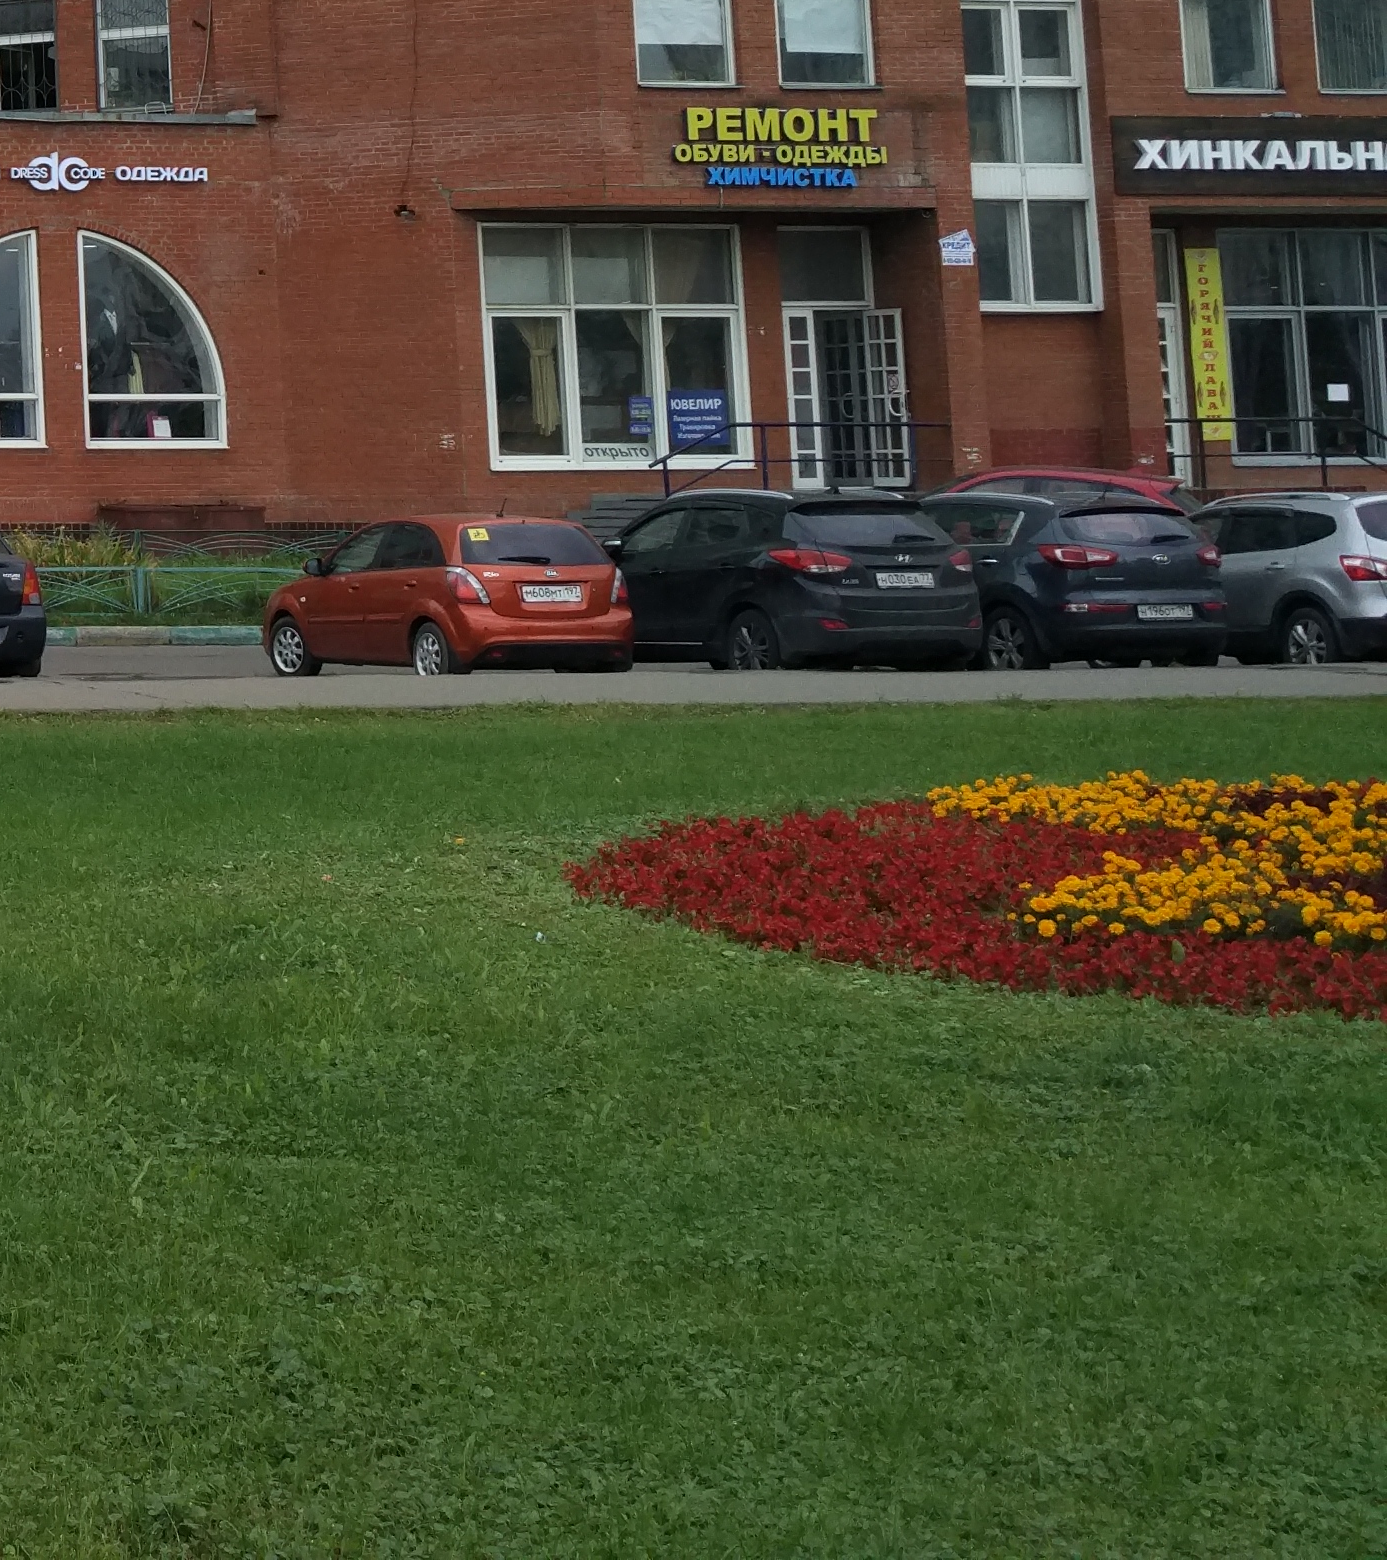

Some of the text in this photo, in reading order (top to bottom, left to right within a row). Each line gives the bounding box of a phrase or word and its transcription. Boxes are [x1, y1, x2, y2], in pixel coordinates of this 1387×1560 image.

[686, 107, 878, 142] РЕМОНТ
[674, 144, 755, 162] ОБУВИ
[776, 145, 888, 167] ОДЕЖДЫ
[1132, 139, 1387, 171] ХИНКАЛЬН
[11, 168, 106, 180] DRESS CODE
[115, 167, 208, 182] ОДЕЖДА
[707, 166, 858, 187] ХИМЧИСТКА
[1197, 264, 1215, 348] ГОРЯЧИЙ
[670, 398, 722, 410] ЮВЕЛИР
[584, 447, 649, 460] открыто
